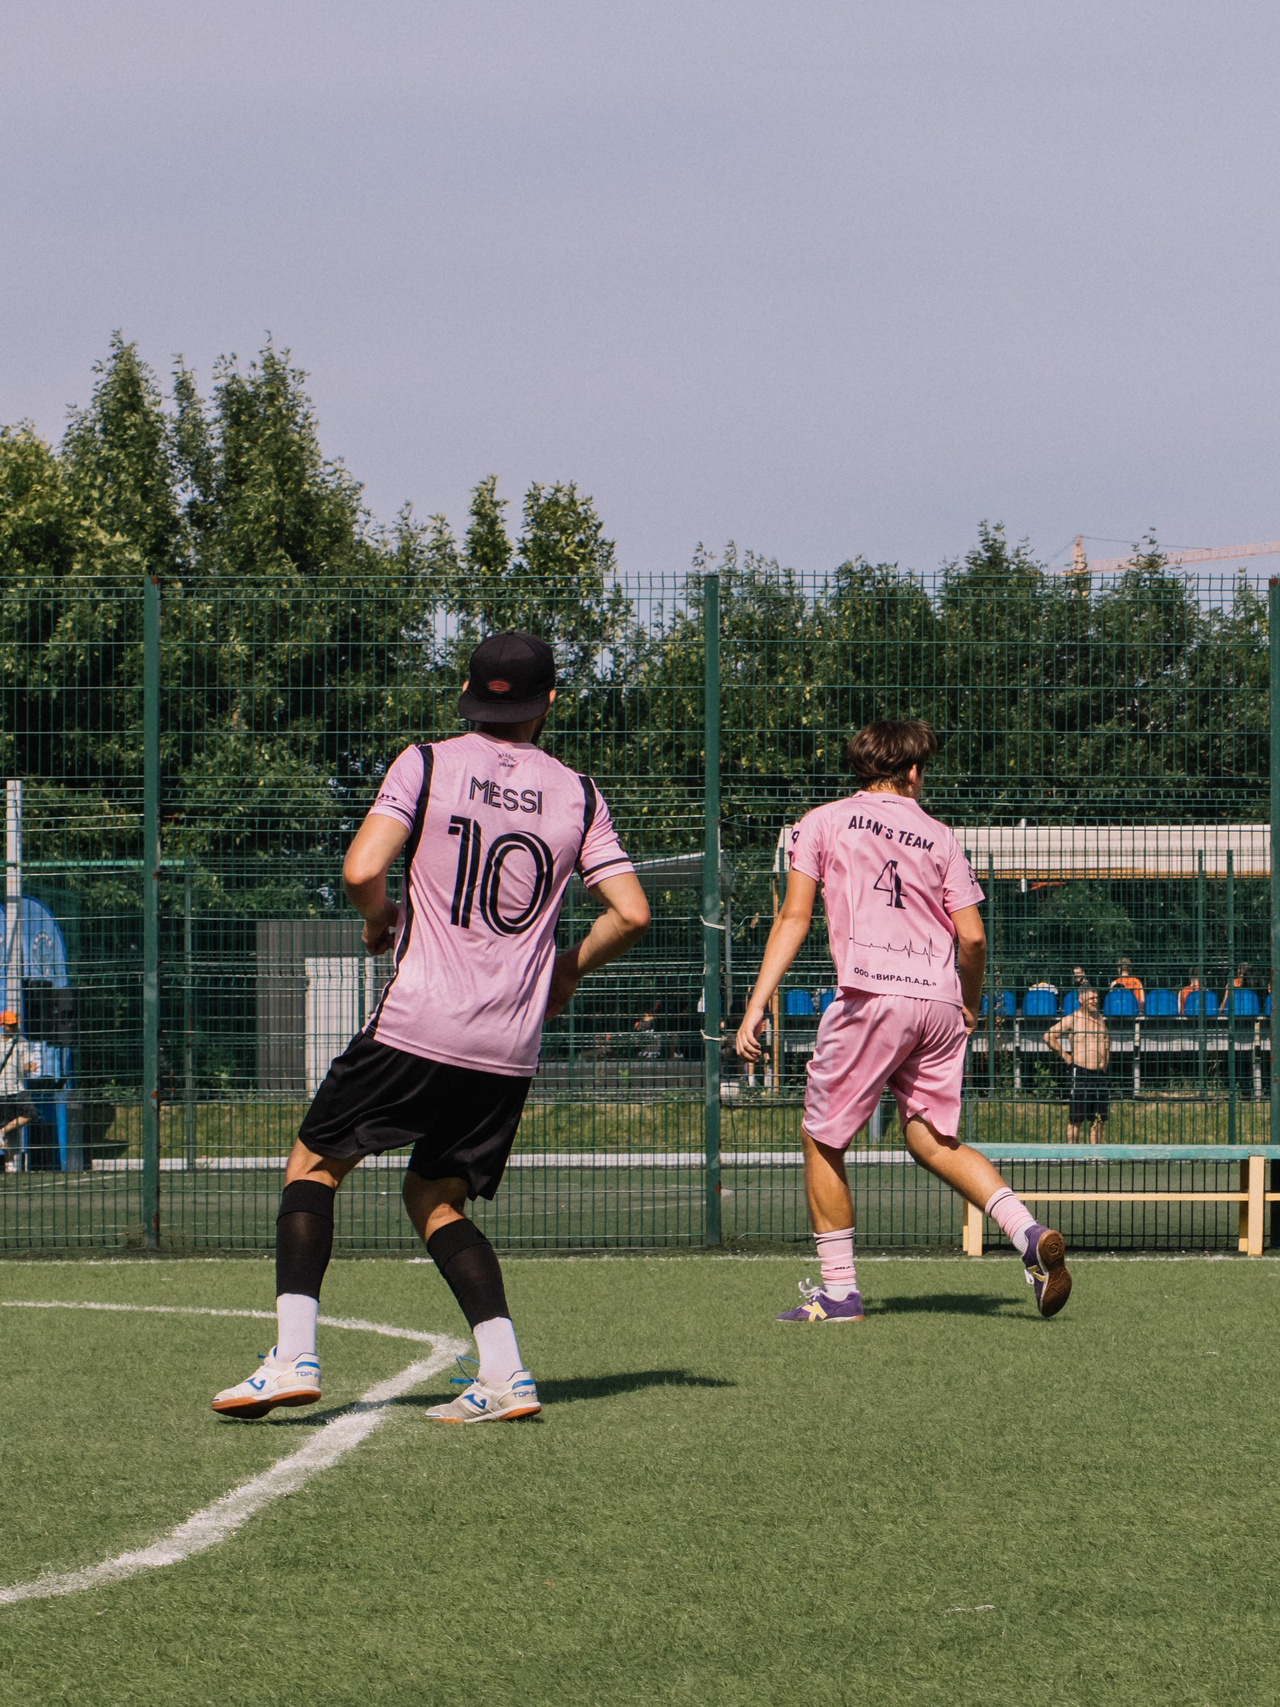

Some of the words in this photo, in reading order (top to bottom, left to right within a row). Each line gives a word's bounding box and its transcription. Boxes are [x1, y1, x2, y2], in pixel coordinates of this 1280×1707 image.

[469, 776, 543, 815] MESSI
[898, 830, 935, 853] TEAM
[447, 815, 554, 938] 10
[873, 859, 908, 910] 4
[854, 967, 869, 978] ООО
